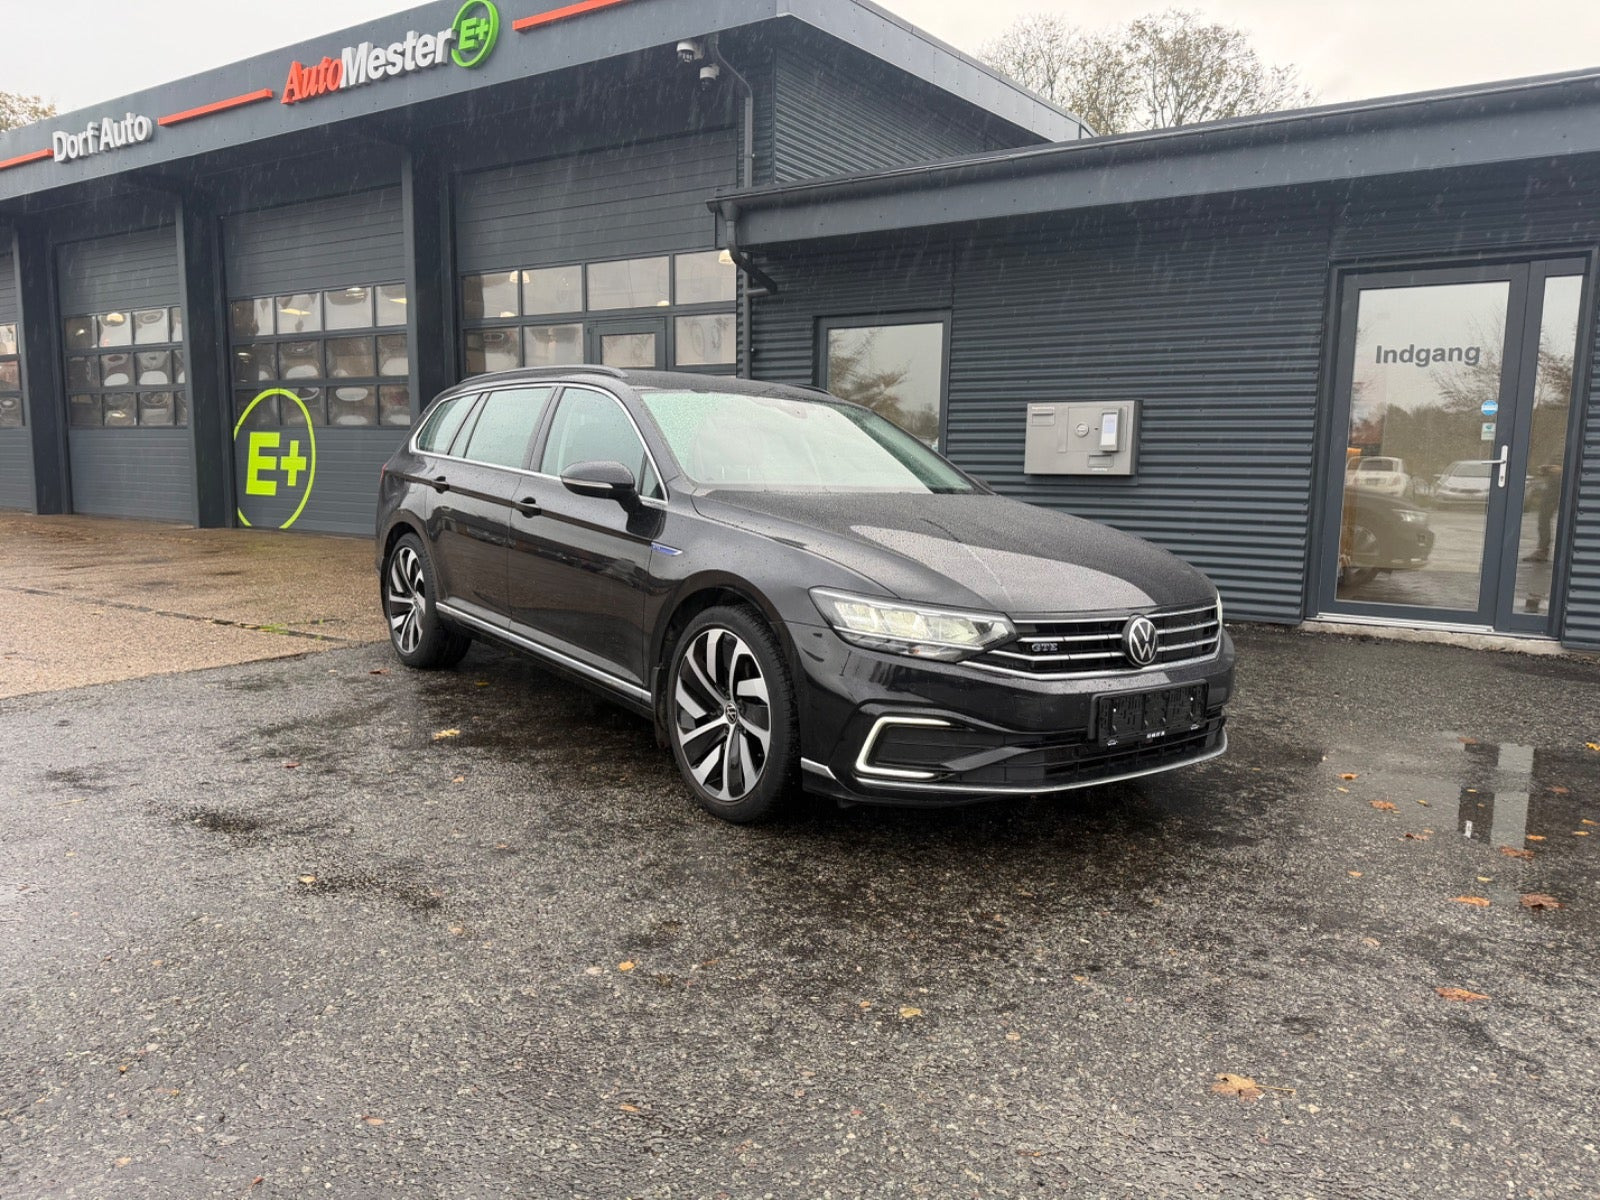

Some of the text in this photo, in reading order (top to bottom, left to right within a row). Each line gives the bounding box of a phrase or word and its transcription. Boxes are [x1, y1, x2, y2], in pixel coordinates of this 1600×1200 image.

[281, 28, 456, 104] AutoMester
[52, 112, 153, 162] Dorf Auto
[1375, 343, 1481, 368] Indgang
[245, 431, 307, 496] E+
[1031, 642, 1059, 652] GTE
